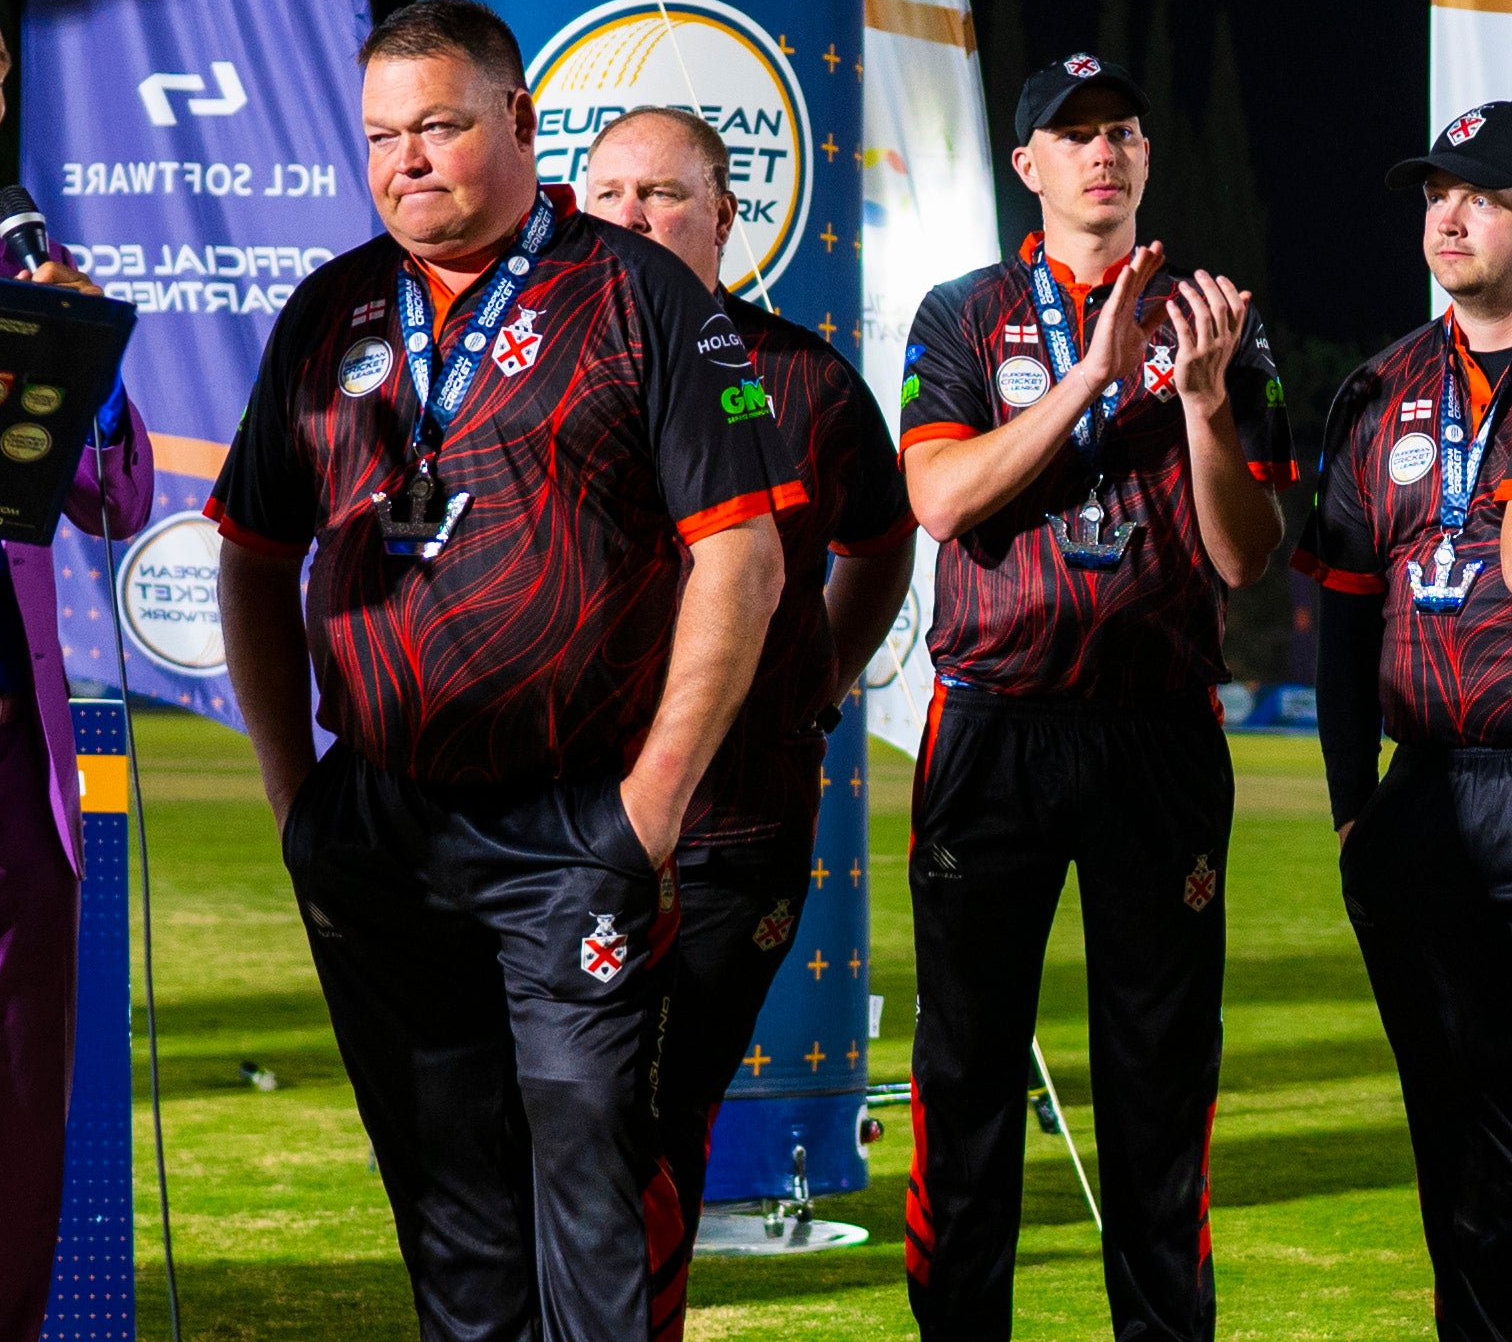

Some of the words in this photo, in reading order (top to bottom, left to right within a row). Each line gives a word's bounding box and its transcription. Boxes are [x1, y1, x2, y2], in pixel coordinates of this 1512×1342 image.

[521, 205, 545, 250] EUROPEAN
[527, 208, 554, 254] CRICKET
[405, 278, 416, 327] EUROPEAN
[414, 280, 425, 327] CRICKET
[478, 277, 508, 327] EUROPEAN
[485, 280, 516, 328] CRICKET
[1038, 267, 1054, 304] CRICKET
[697, 333, 745, 354] HOLG
[1050, 329, 1065, 373] EUROPEAN
[437, 355, 465, 407] EUROPEAN
[444, 357, 473, 411] CRICKET
[721, 379, 766, 415] GM
[1001, 378, 1043, 386] CRICKET
[1394, 446, 1431, 458] EUROPEAN
[1394, 452, 1431, 466] CRICKET
[1399, 459, 1427, 470] LEAGUE
[1447, 448, 1455, 495] EUROPEAN
[1454, 449, 1463, 495] CRICKET
